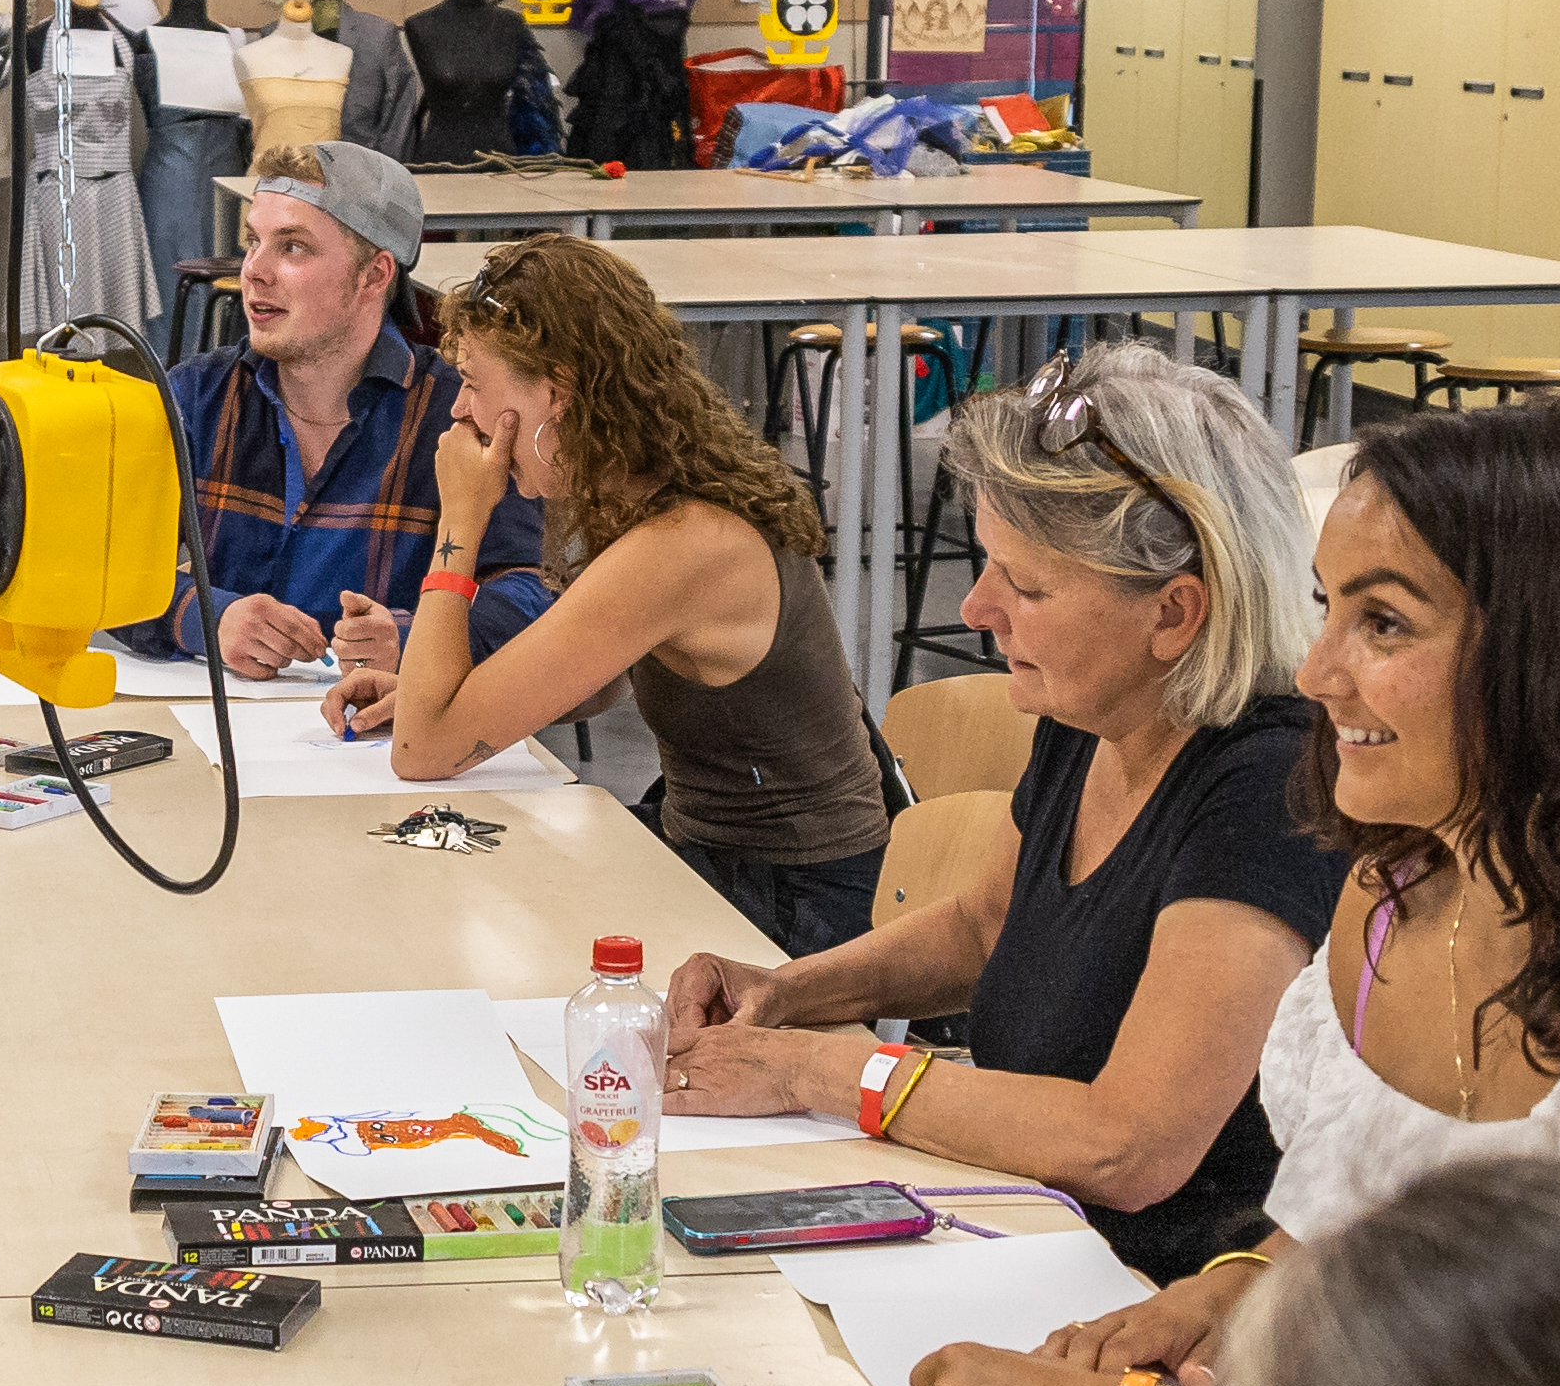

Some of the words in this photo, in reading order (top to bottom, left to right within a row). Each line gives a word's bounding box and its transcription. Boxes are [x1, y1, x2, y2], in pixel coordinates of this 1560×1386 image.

[584, 1075, 632, 1091] SPA
[580, 1106, 637, 1116] GRAPEFRUIT
[209, 1207, 369, 1221] PANDA
[183, 1253, 197, 1263] 12
[363, 1245, 416, 1259] PANDA
[93, 1276, 253, 1308] PANDA
[39, 1305, 54, 1317] 12
